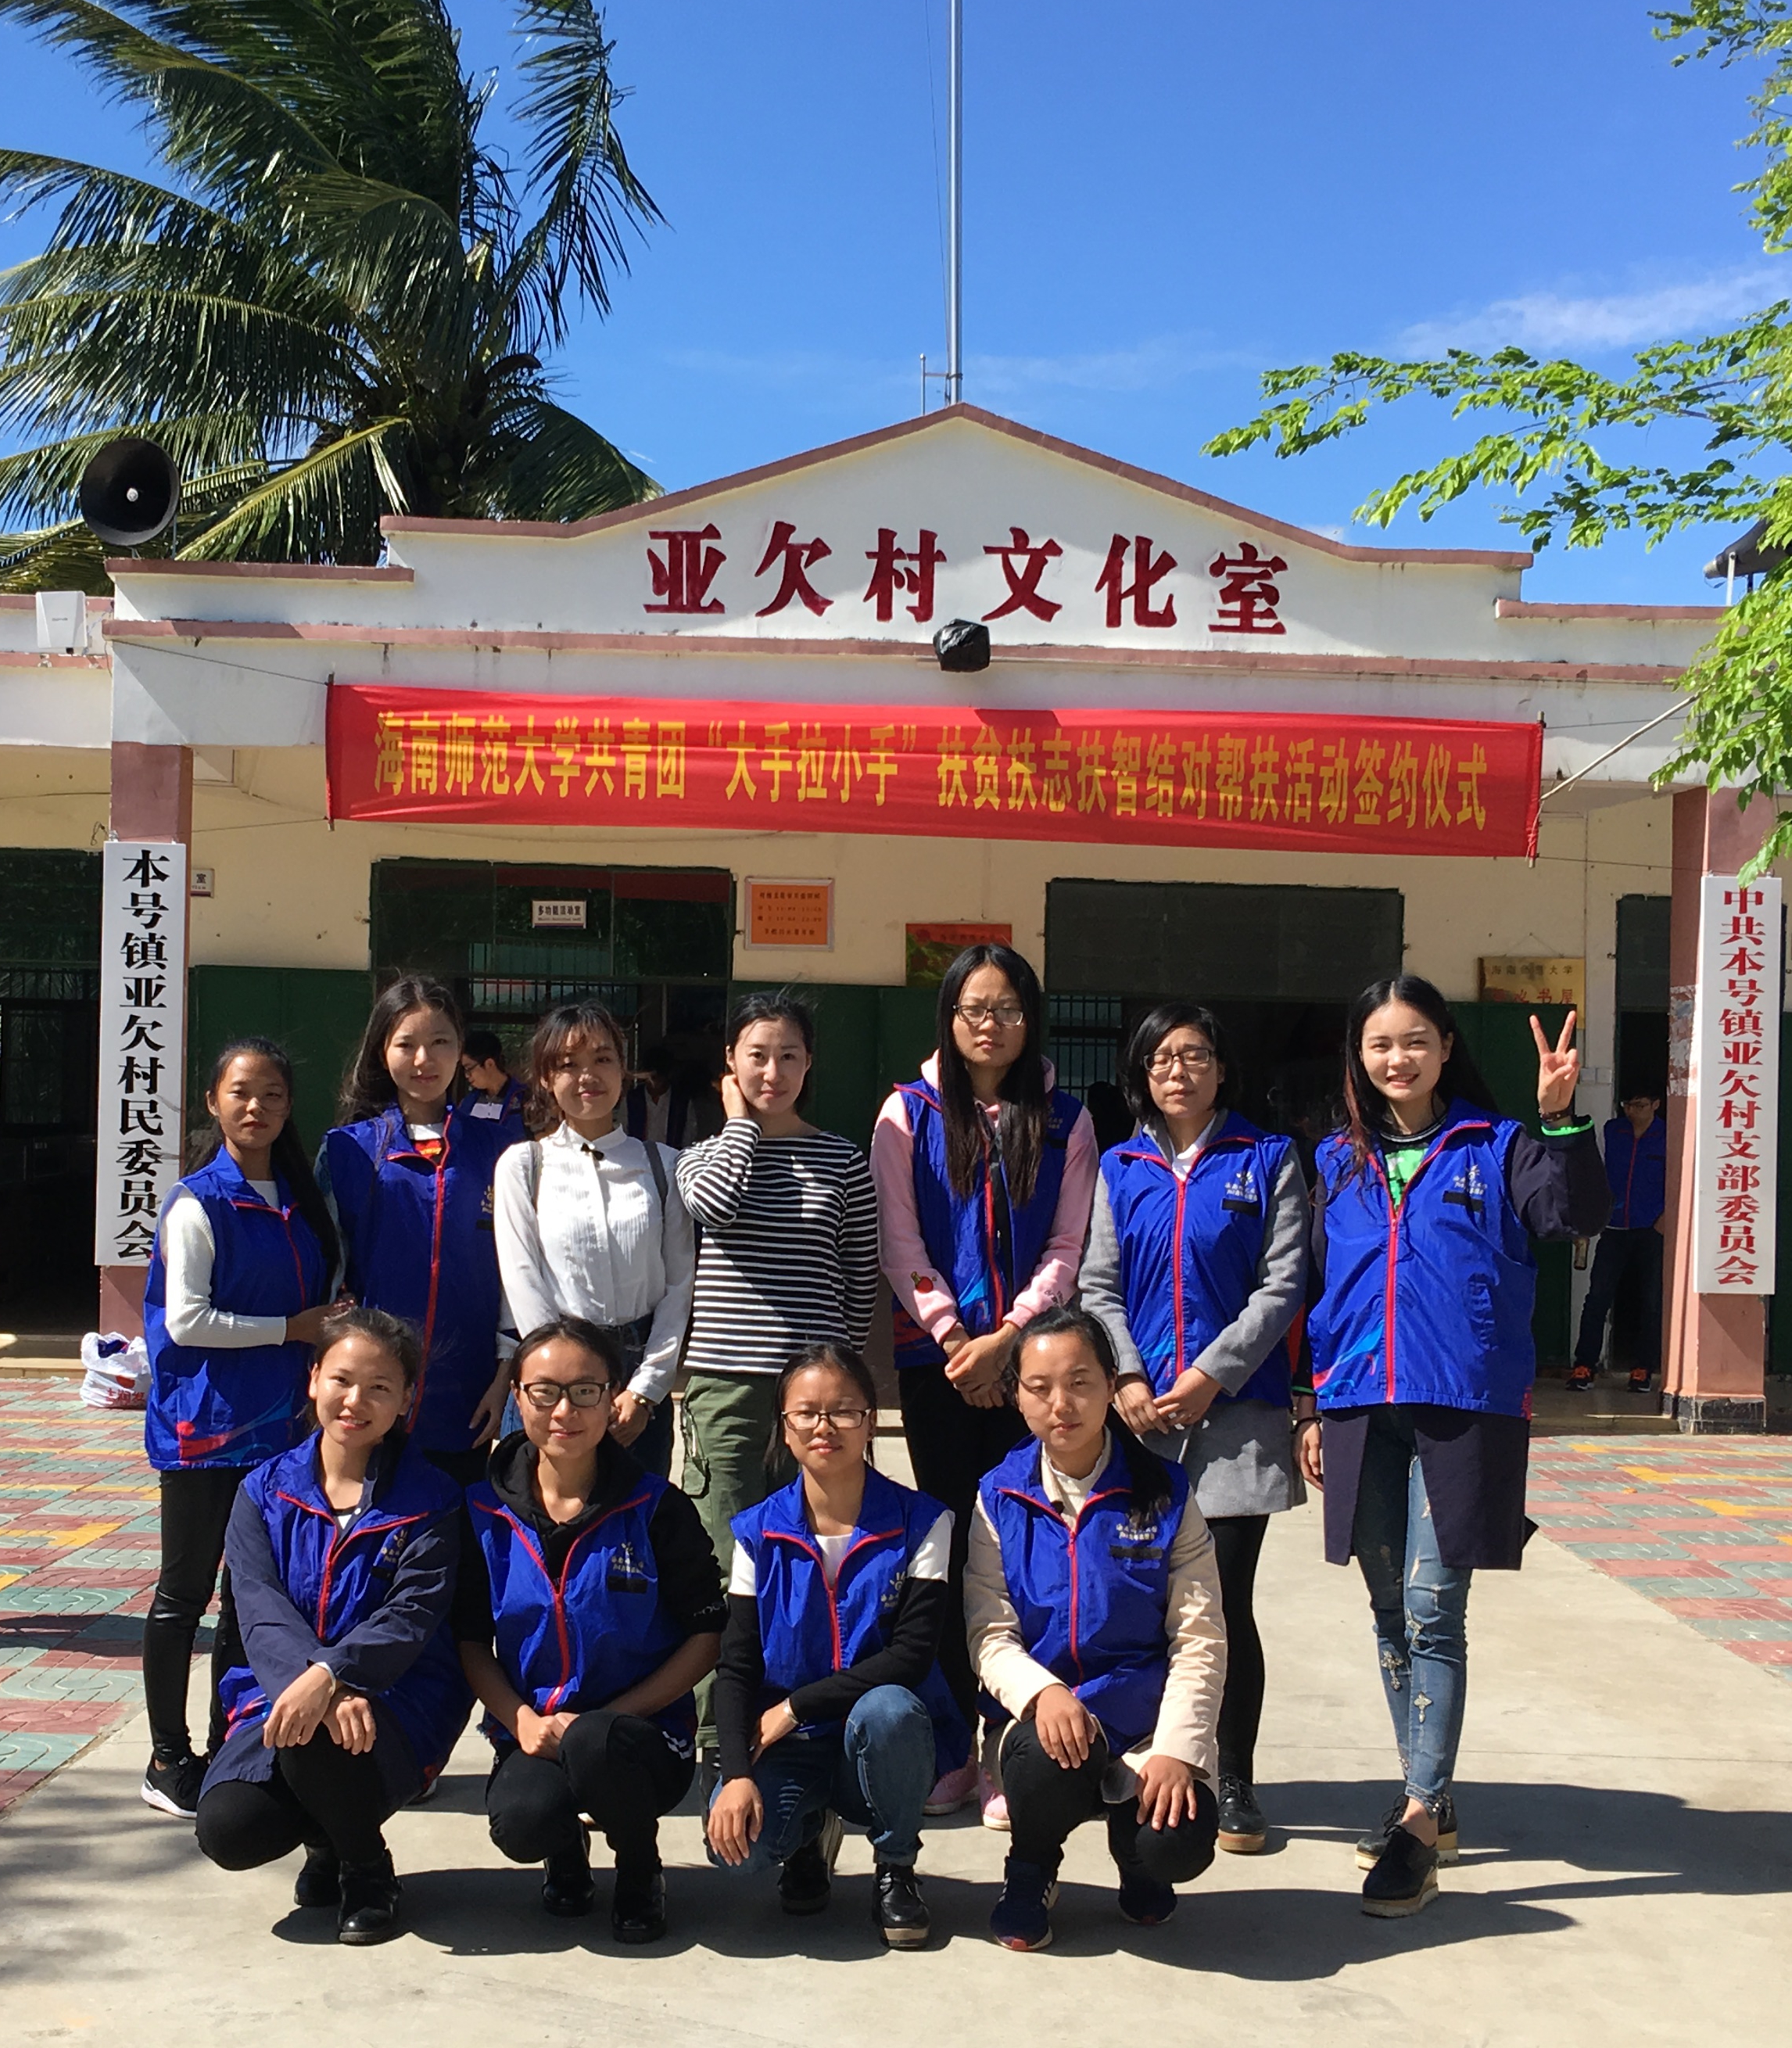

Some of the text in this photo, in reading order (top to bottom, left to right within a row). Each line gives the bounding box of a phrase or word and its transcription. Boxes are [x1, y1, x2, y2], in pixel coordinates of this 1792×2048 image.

[643, 522, 1287, 635] 亚欠村文化室
[116, 849, 170, 1261] 本号镇亚欠村民委员会
[1715, 888, 1765, 1286] 中共本号镇亚欠村支部委员会
